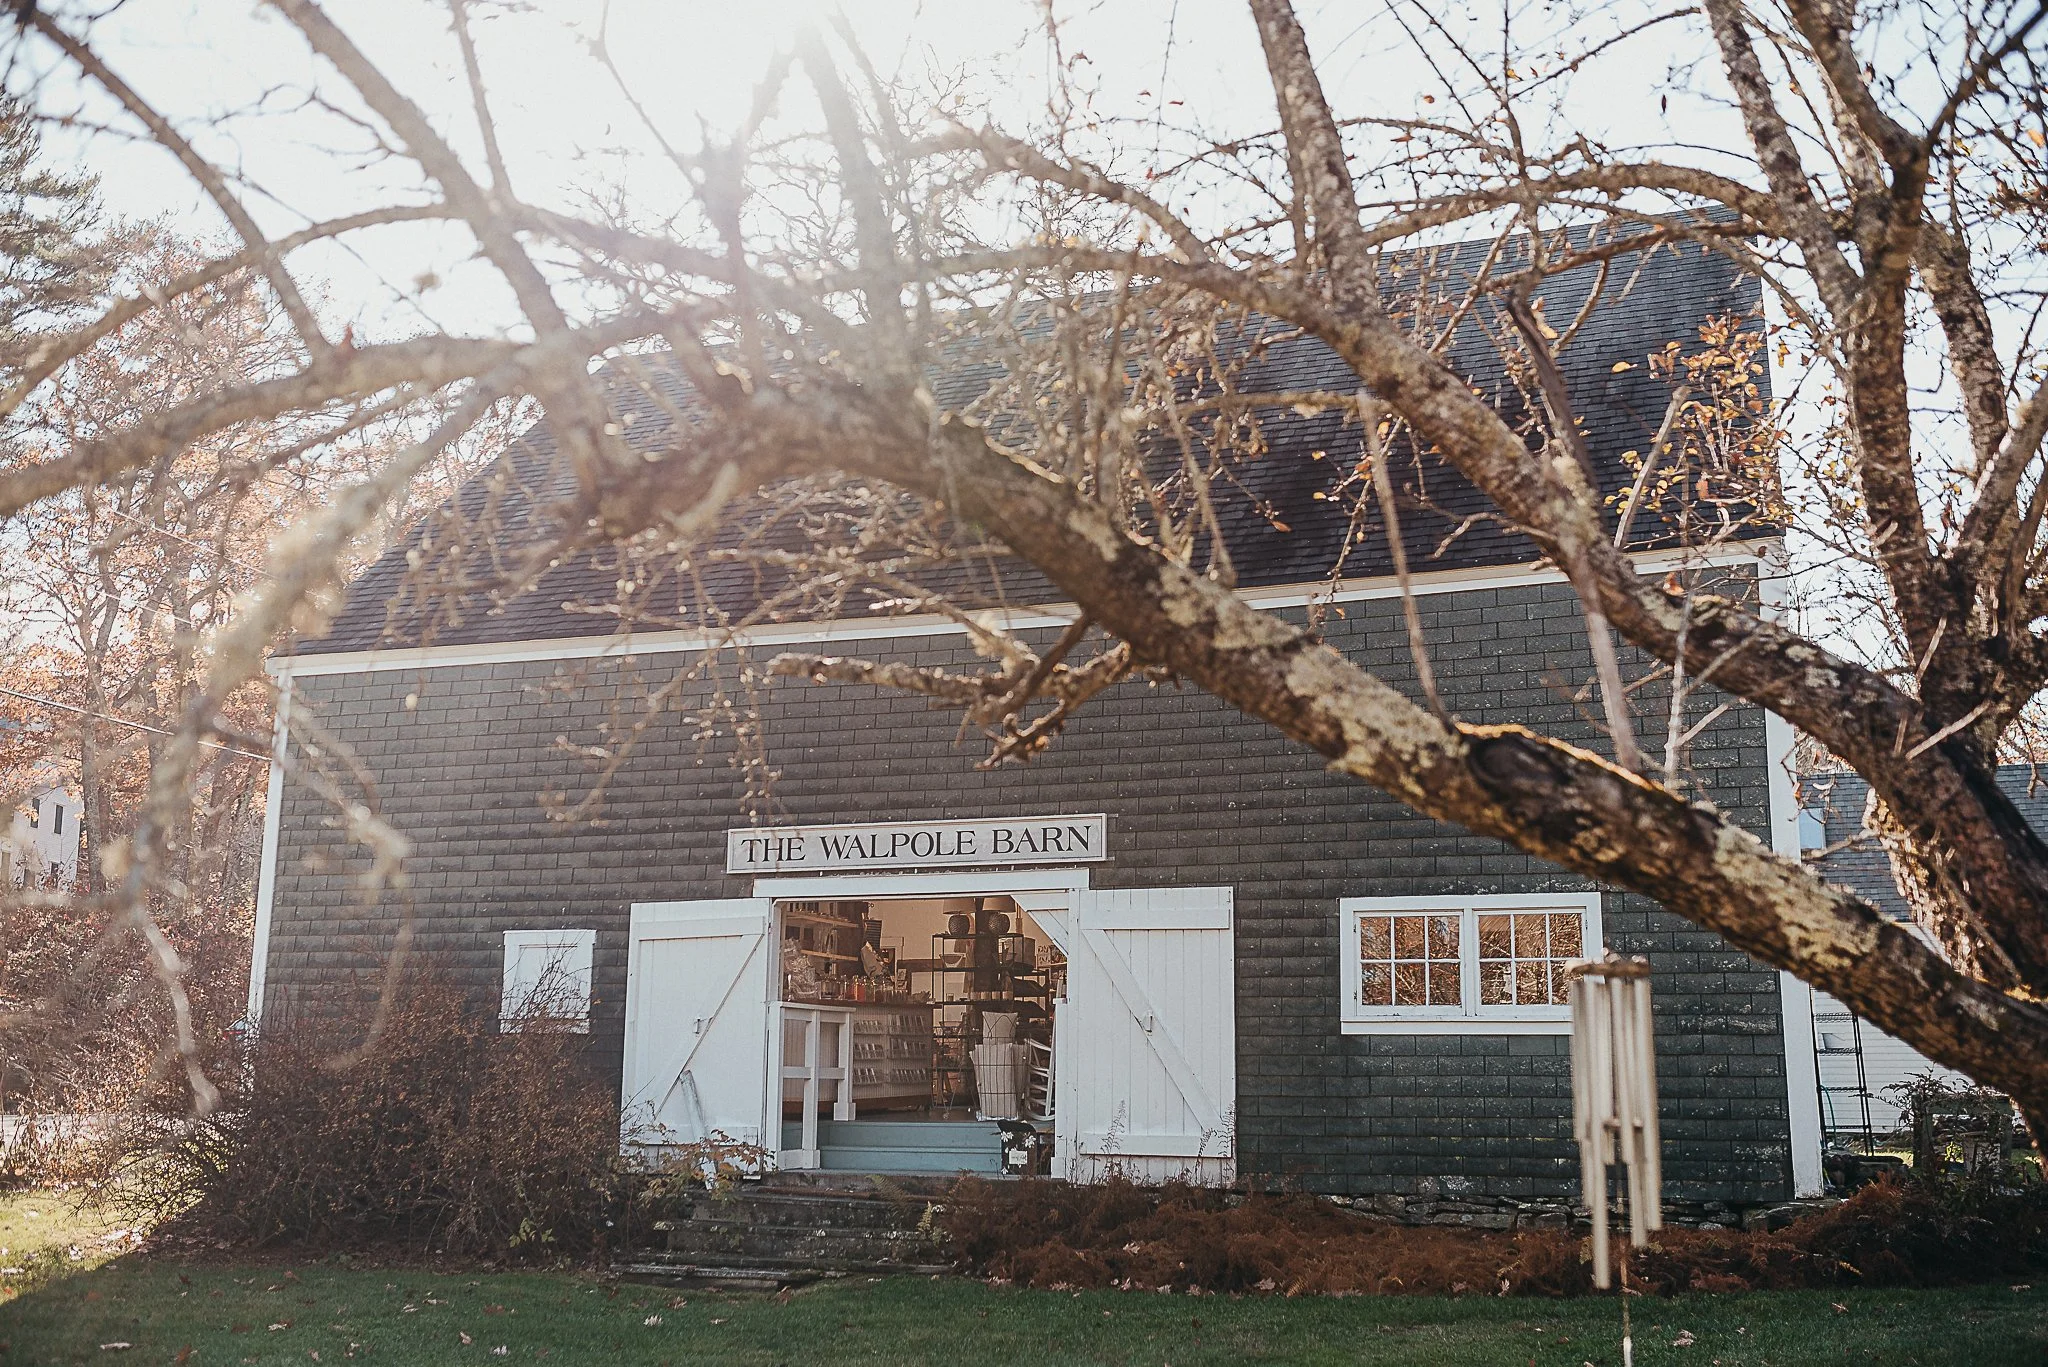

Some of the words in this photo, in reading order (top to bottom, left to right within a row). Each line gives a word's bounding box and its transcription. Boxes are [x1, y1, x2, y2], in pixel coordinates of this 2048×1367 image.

[741, 836, 805, 863] THE
[820, 830, 976, 860] WALPOLE
[991, 825, 1092, 854] BARN
